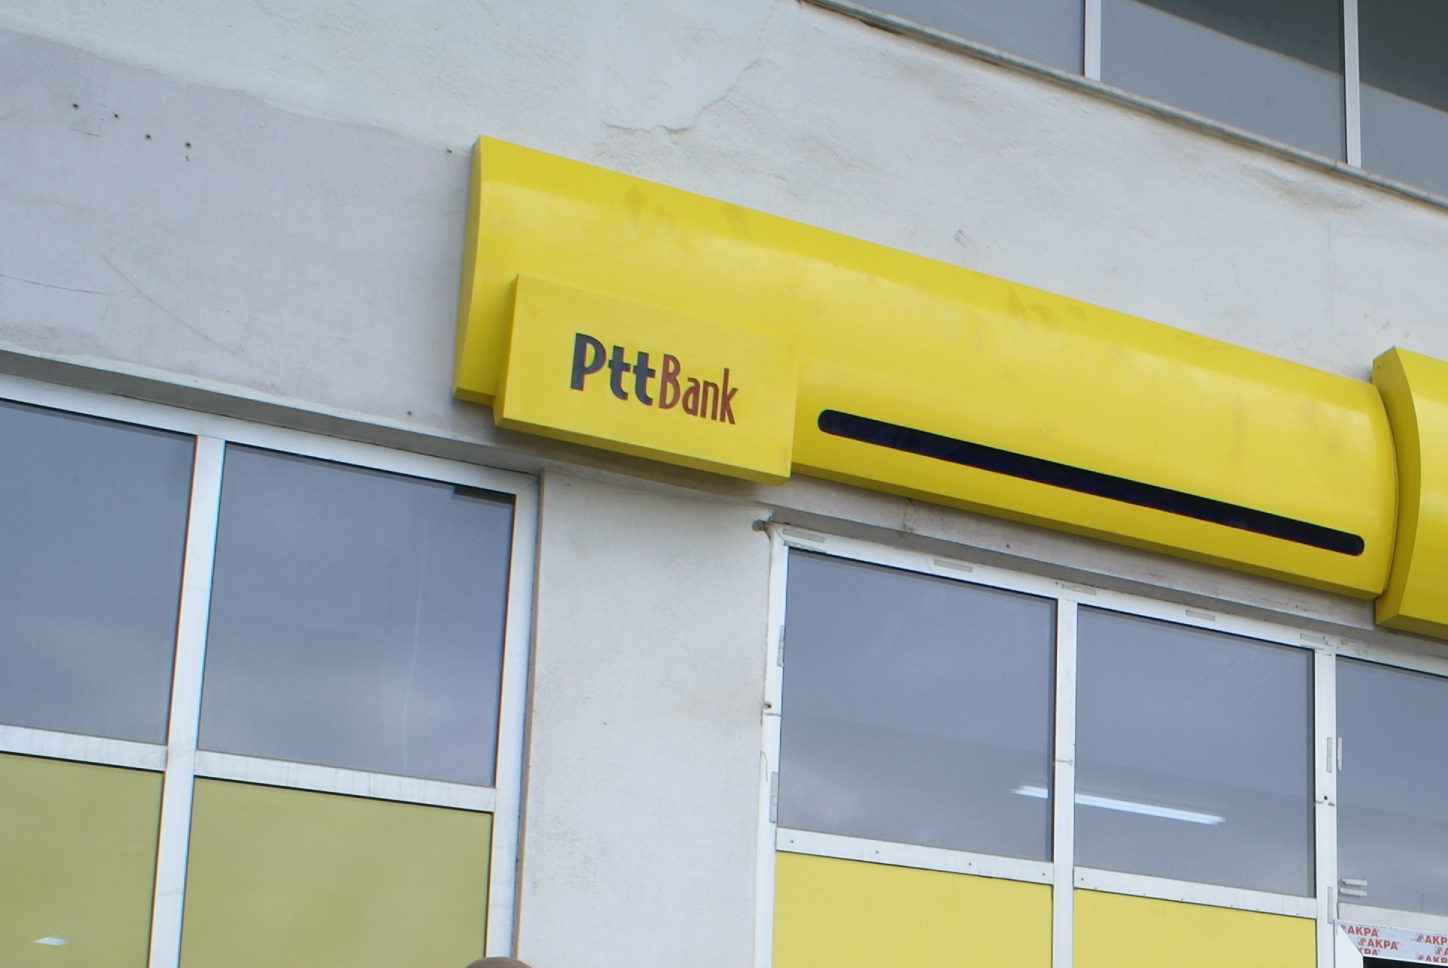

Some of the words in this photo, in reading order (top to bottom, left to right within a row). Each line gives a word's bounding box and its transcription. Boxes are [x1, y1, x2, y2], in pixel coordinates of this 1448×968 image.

[570, 332, 738, 425] PttBank
[1347, 925, 1379, 937] AKPA
[1367, 938, 1399, 950] AKPA
